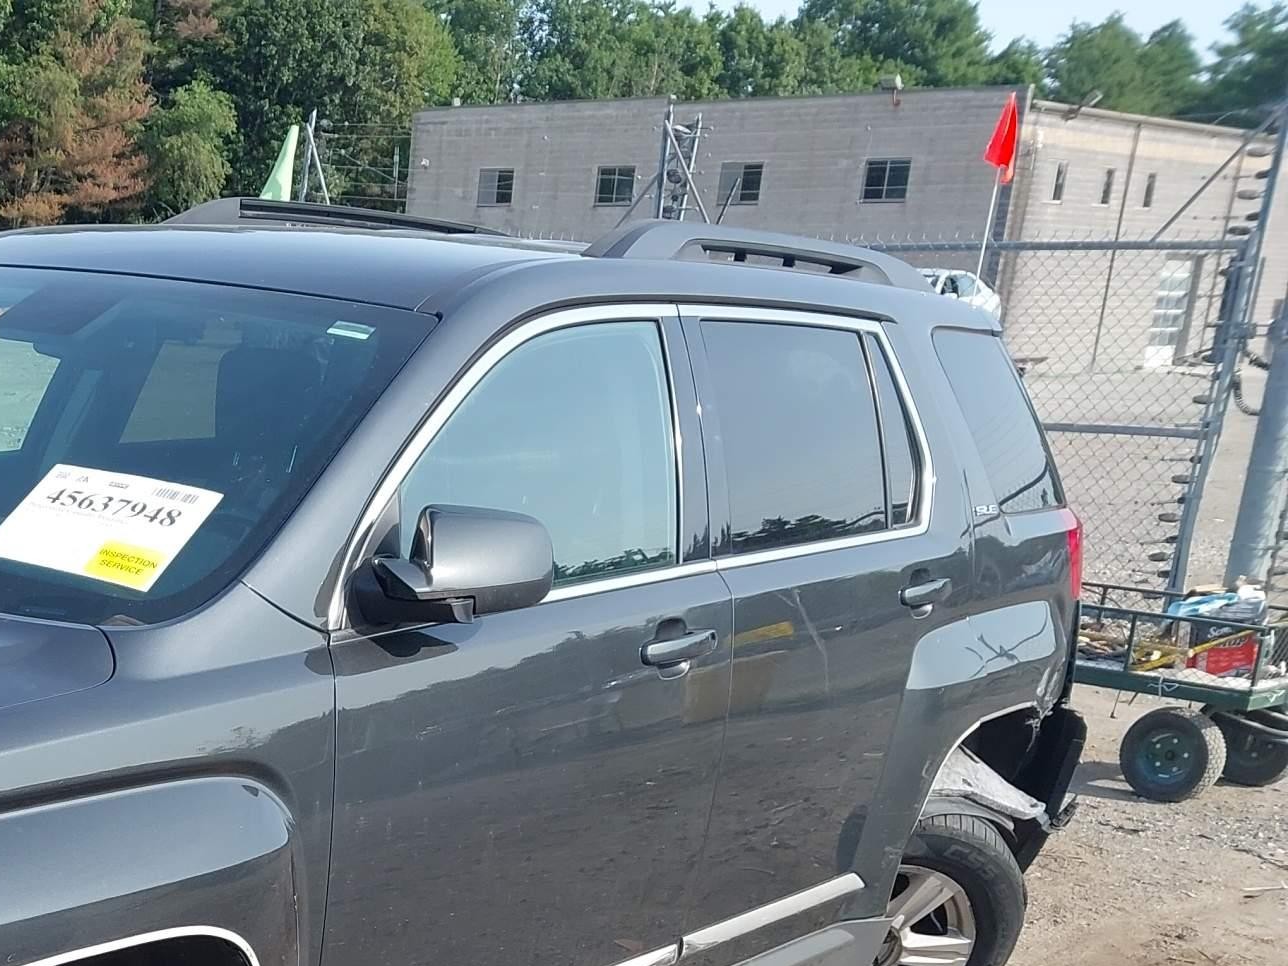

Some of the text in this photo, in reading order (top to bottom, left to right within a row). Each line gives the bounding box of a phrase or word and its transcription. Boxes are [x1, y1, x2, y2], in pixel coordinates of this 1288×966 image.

[46, 487, 182, 527] 45637948
[99, 548, 159, 569] INSPECTION
[99, 559, 144, 576] SERVICE
